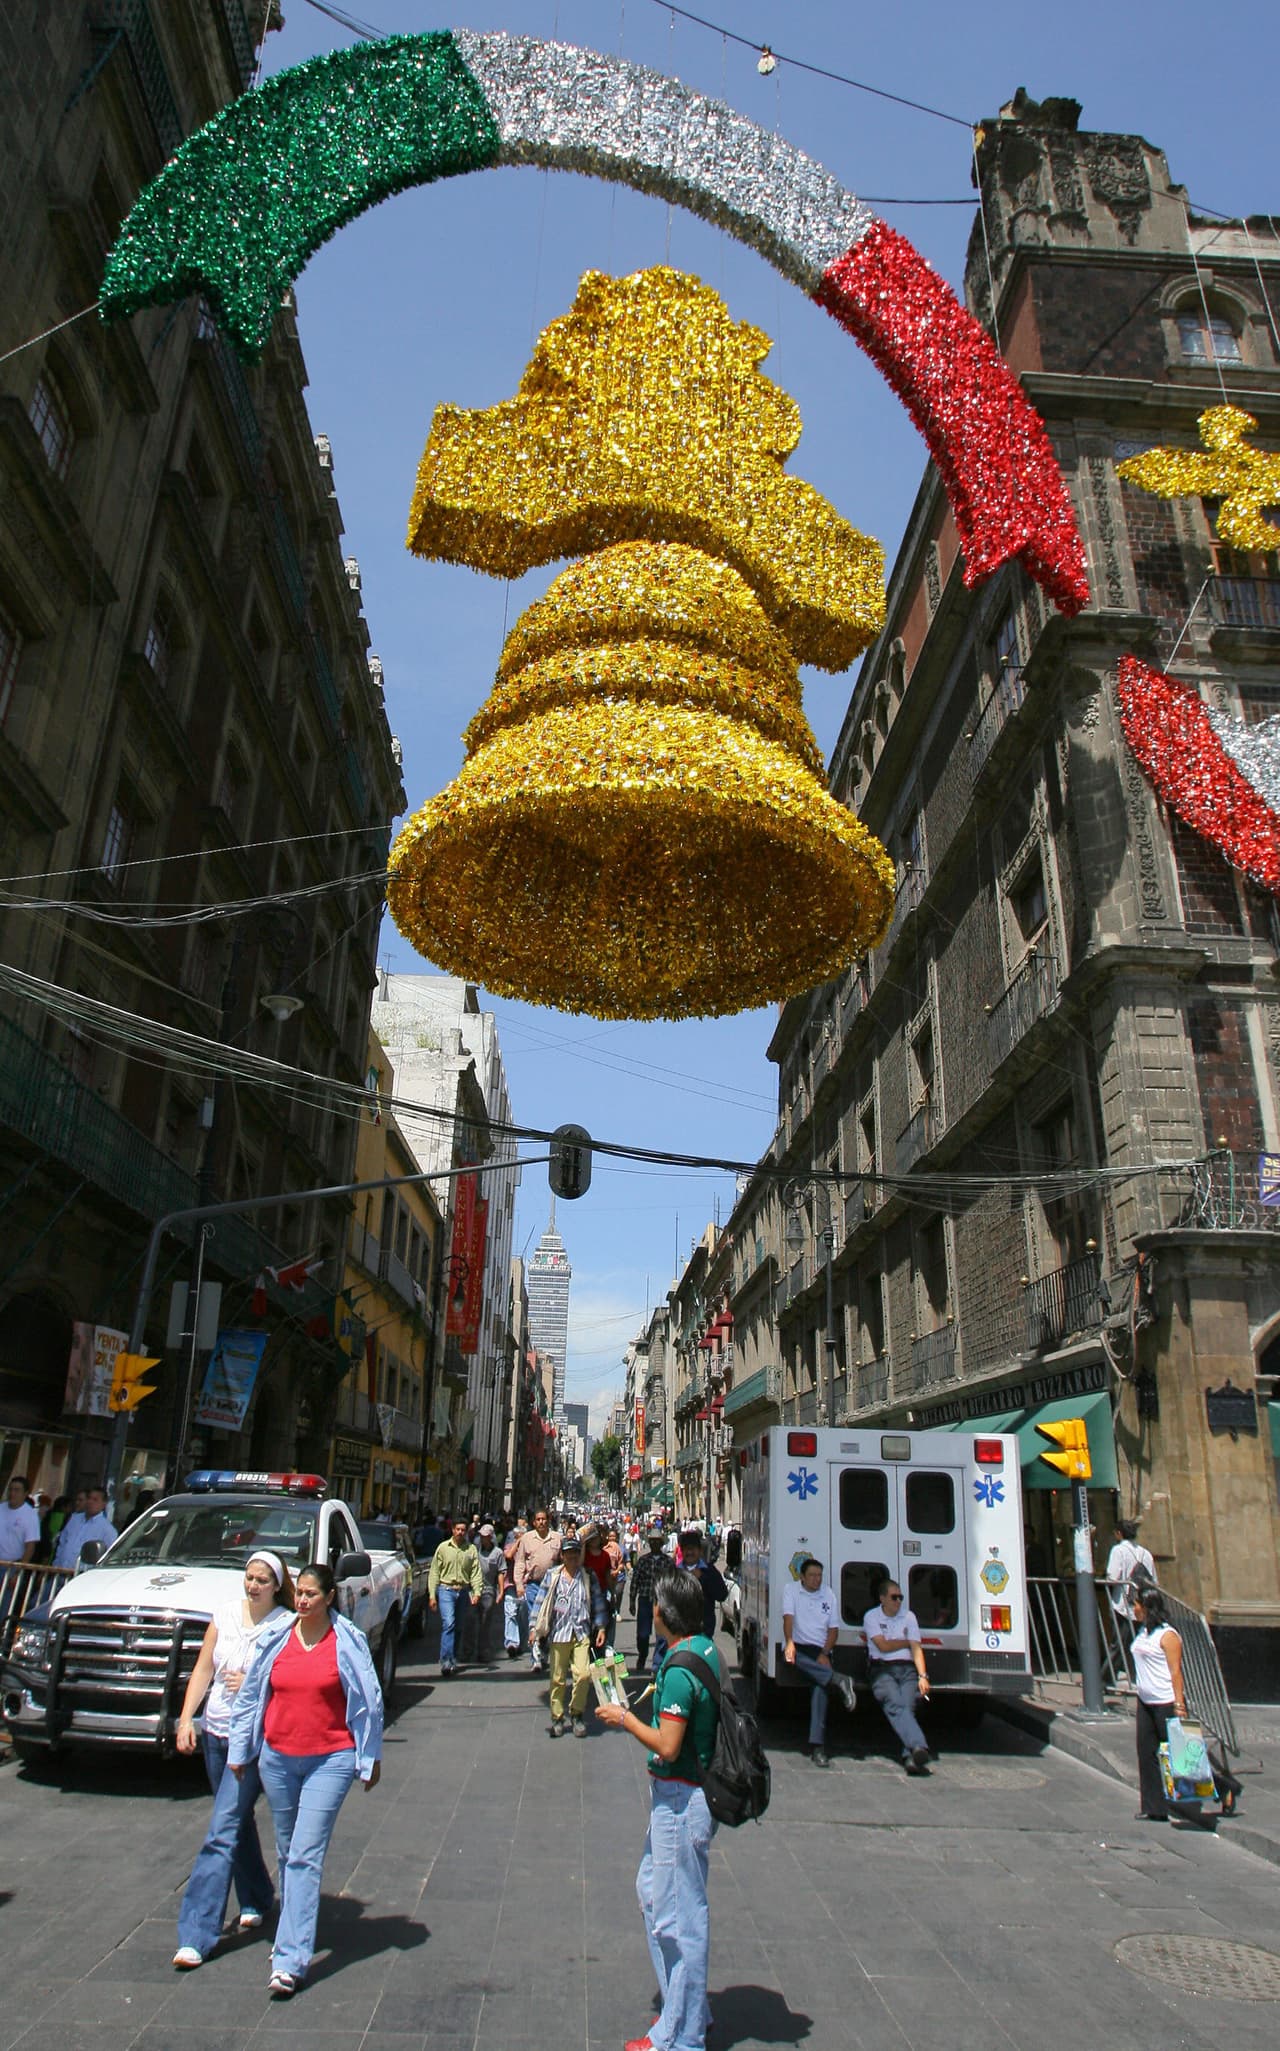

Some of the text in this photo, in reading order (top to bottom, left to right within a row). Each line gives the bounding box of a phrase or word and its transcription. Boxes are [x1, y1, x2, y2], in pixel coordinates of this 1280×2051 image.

[455, 1184, 468, 1239] CENTRO
[97, 1333, 120, 1352] VENTA
[1034, 1366, 1103, 1401] BIZZARRO
[969, 1387, 1022, 1416] BIZZARRO
[987, 1635, 998, 1647] 6
